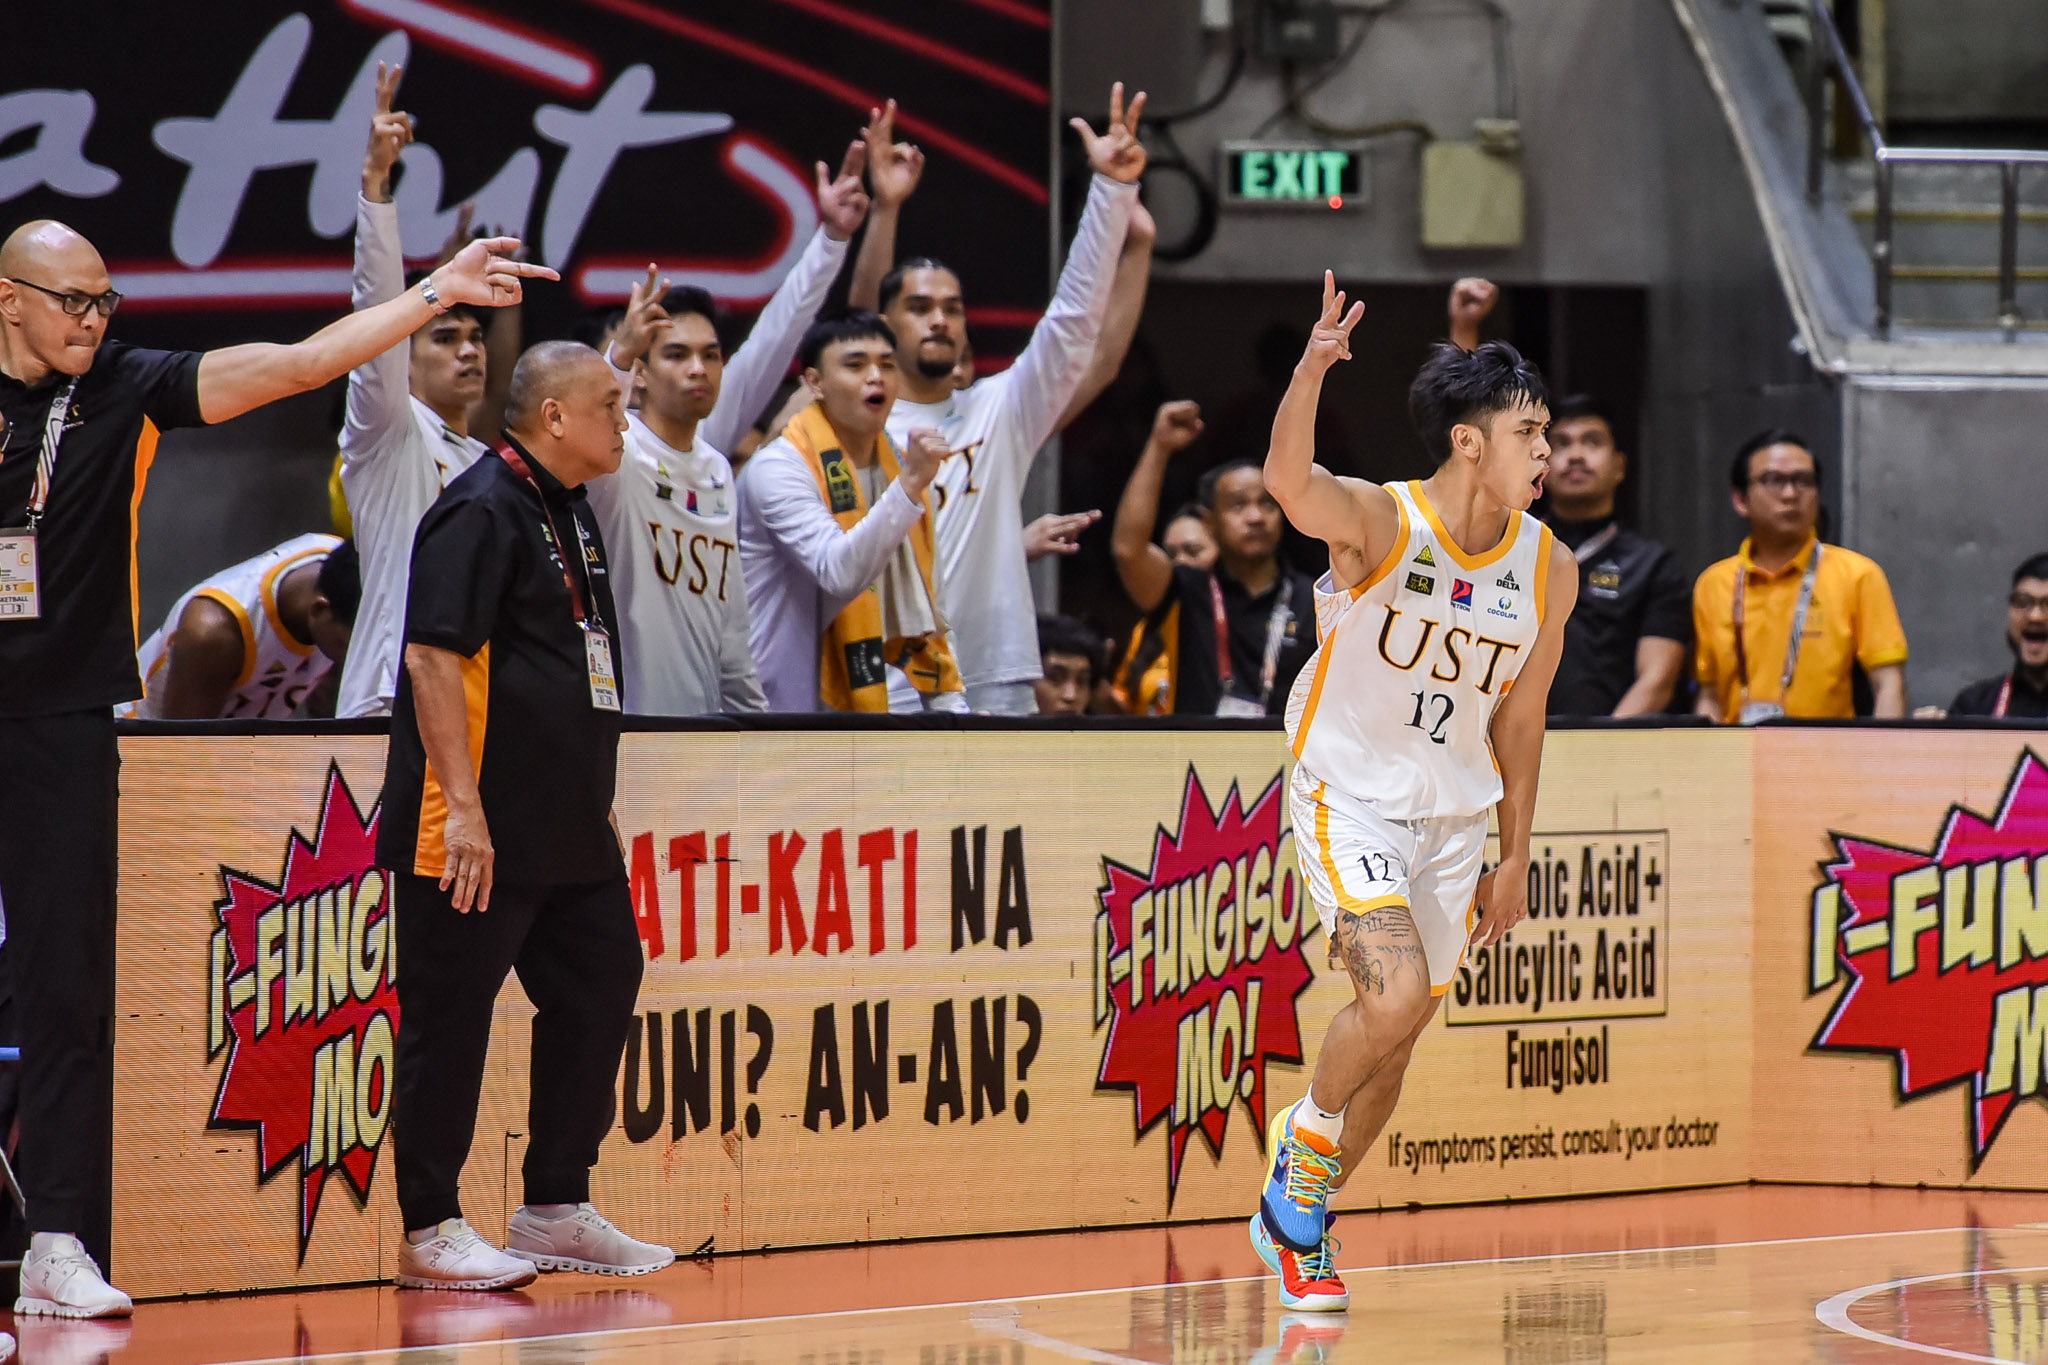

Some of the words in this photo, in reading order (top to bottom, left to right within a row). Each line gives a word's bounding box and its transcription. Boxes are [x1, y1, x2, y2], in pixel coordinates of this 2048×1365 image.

[153, 12, 734, 270] Hut
[1240, 150, 1349, 199] EXIT
[648, 521, 735, 602] UST
[1496, 578, 1520, 592] DELTA
[1450, 601, 1471, 613] PETRON
[1486, 607, 1519, 620] COCOLIFE
[1377, 603, 1522, 695] UST
[1404, 689, 1455, 745] 12
[630, 827, 918, 964] ATI-KATI
[950, 824, 1033, 953] NA
[1357, 852, 1397, 883] 12
[1593, 925, 1656, 1000] Acid
[1809, 855, 2048, 995] I-FUN
[307, 1009, 396, 1168] MO
[622, 1003, 774, 1144] UNI?
[803, 993, 1042, 1133] AN-AN?
[1174, 980, 1262, 1127] MO!
[1505, 1023, 1609, 1094] Fungisol
[1388, 1131, 1402, 1168] If
[1404, 1132, 1496, 1175] symptoms
[1500, 1126, 1557, 1169] persist,
[1562, 1118, 1621, 1156] consult
[1625, 1126, 1661, 1160] your
[1665, 1114, 1719, 1149] doctor
